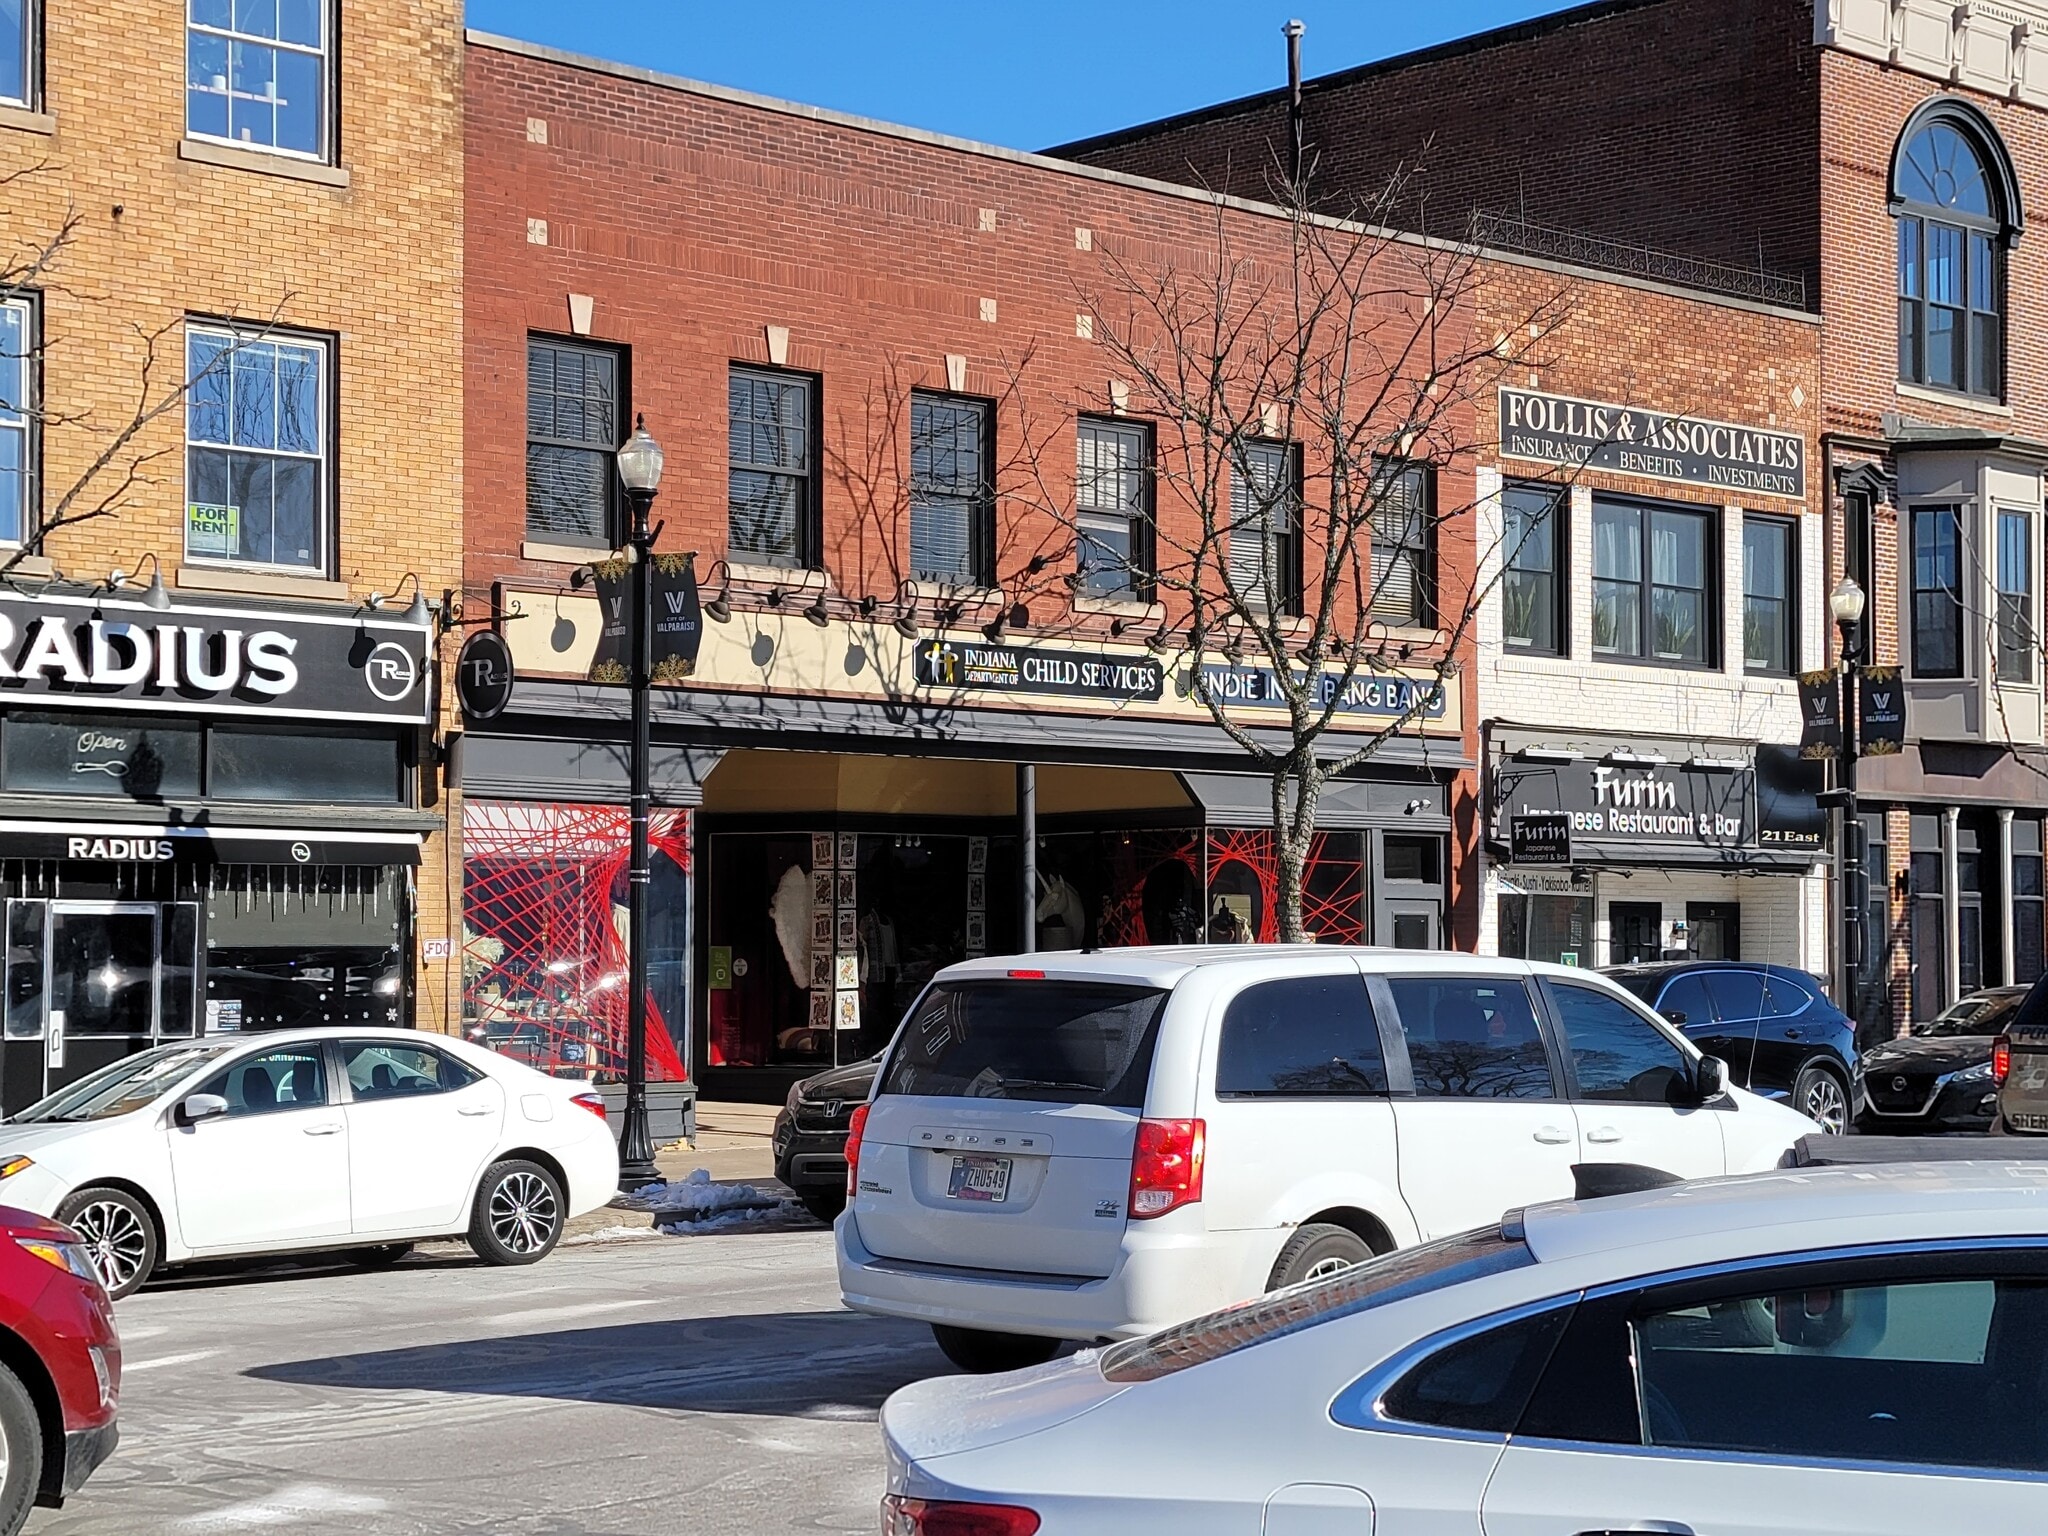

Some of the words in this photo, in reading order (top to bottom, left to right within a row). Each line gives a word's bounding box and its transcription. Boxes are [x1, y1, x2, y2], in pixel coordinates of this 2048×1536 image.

[1508, 394, 1609, 440] FOLLIS
[1616, 411, 1637, 445] &
[1643, 416, 1799, 471] ASSOCIATES
[1511, 434, 1594, 464] INSURANCE
[1619, 452, 1683, 477] BENEFITS
[1708, 465, 1796, 494] INVESTMENTS
[196, 507, 228, 521] FOR
[191, 520, 235, 534] RENT
[657, 621, 695, 632] VALPARAISO
[965, 649, 1018, 669] INDIANA
[965, 670, 1009, 684] DEPARTMENT
[1009, 674, 1019, 685] OF
[1023, 657, 1078, 685] CHILD
[1081, 662, 1156, 692] SERVICES
[77, 731, 127, 753] Open
[1593, 766, 1676, 809] Furin
[1513, 821, 1567, 841] Furin
[1609, 808, 1694, 835] Restaurant
[1700, 813, 1711, 835] &
[1715, 813, 1741, 837] Bar
[1761, 830, 1780, 841] 21
[1784, 831, 1820, 843] East
[68, 837, 174, 860] RADIUS
[1525, 844, 1556, 853] Japanese
[1523, 874, 1538, 891] Sushi
[1541, 875, 1569, 892] Yakisoba
[922, 1132, 1034, 1147] DODGE
[968, 1168, 1006, 1189] ZHU549
